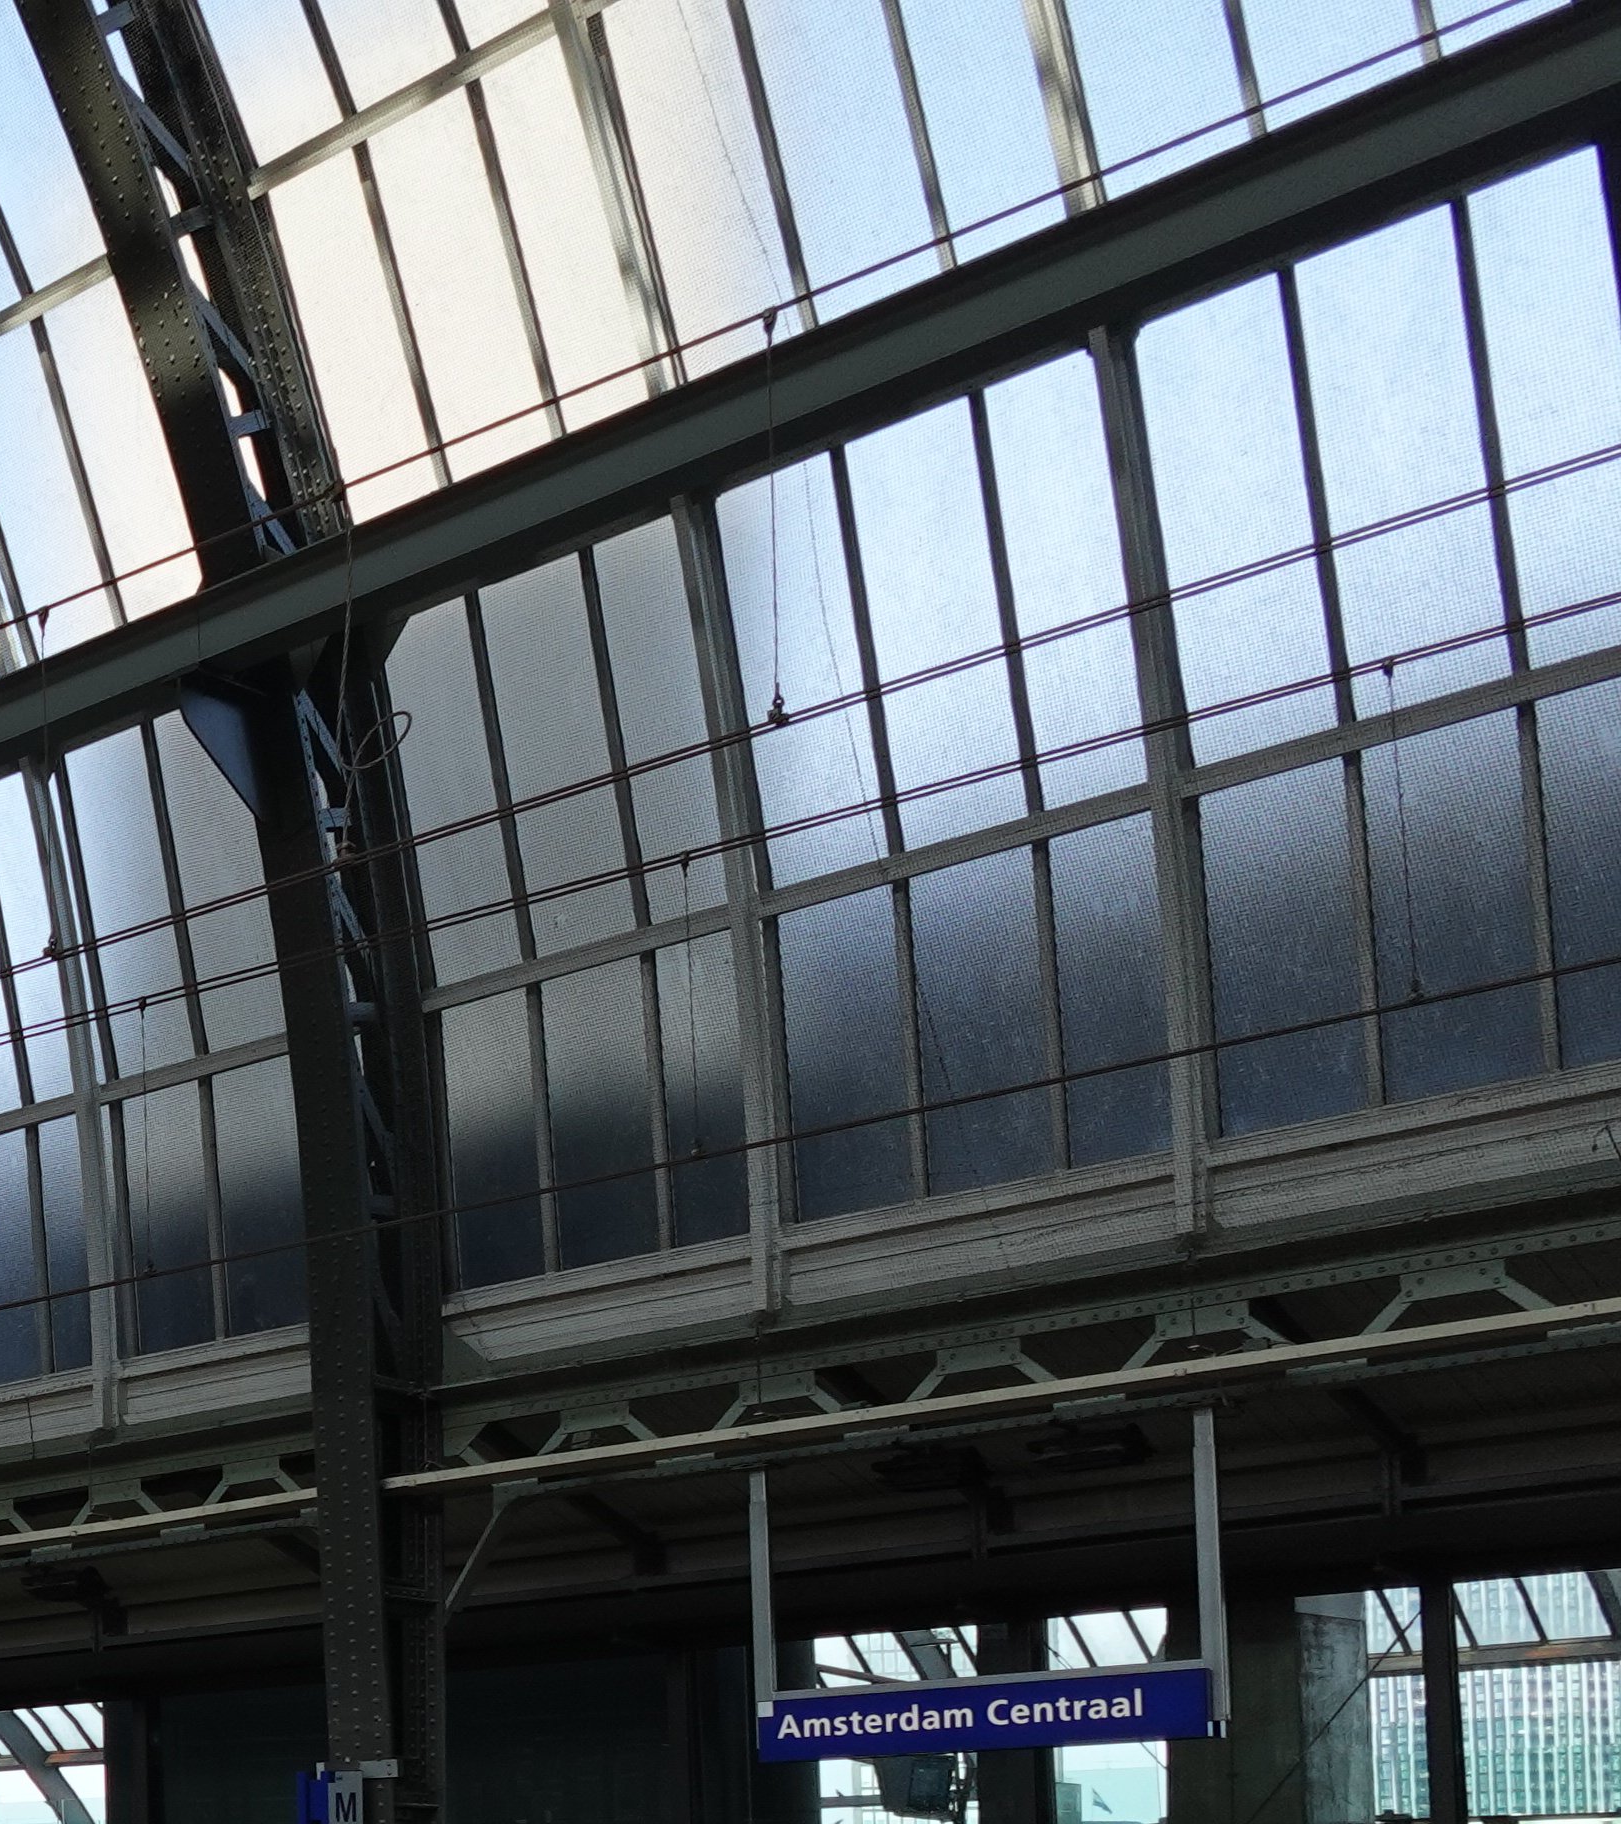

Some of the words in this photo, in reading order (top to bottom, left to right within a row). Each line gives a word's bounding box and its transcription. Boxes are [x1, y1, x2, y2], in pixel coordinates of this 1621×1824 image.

[777, 1703, 974, 1740] Amsterdam
[987, 1688, 1144, 1726] Centraal
[335, 1792, 357, 1823] M
